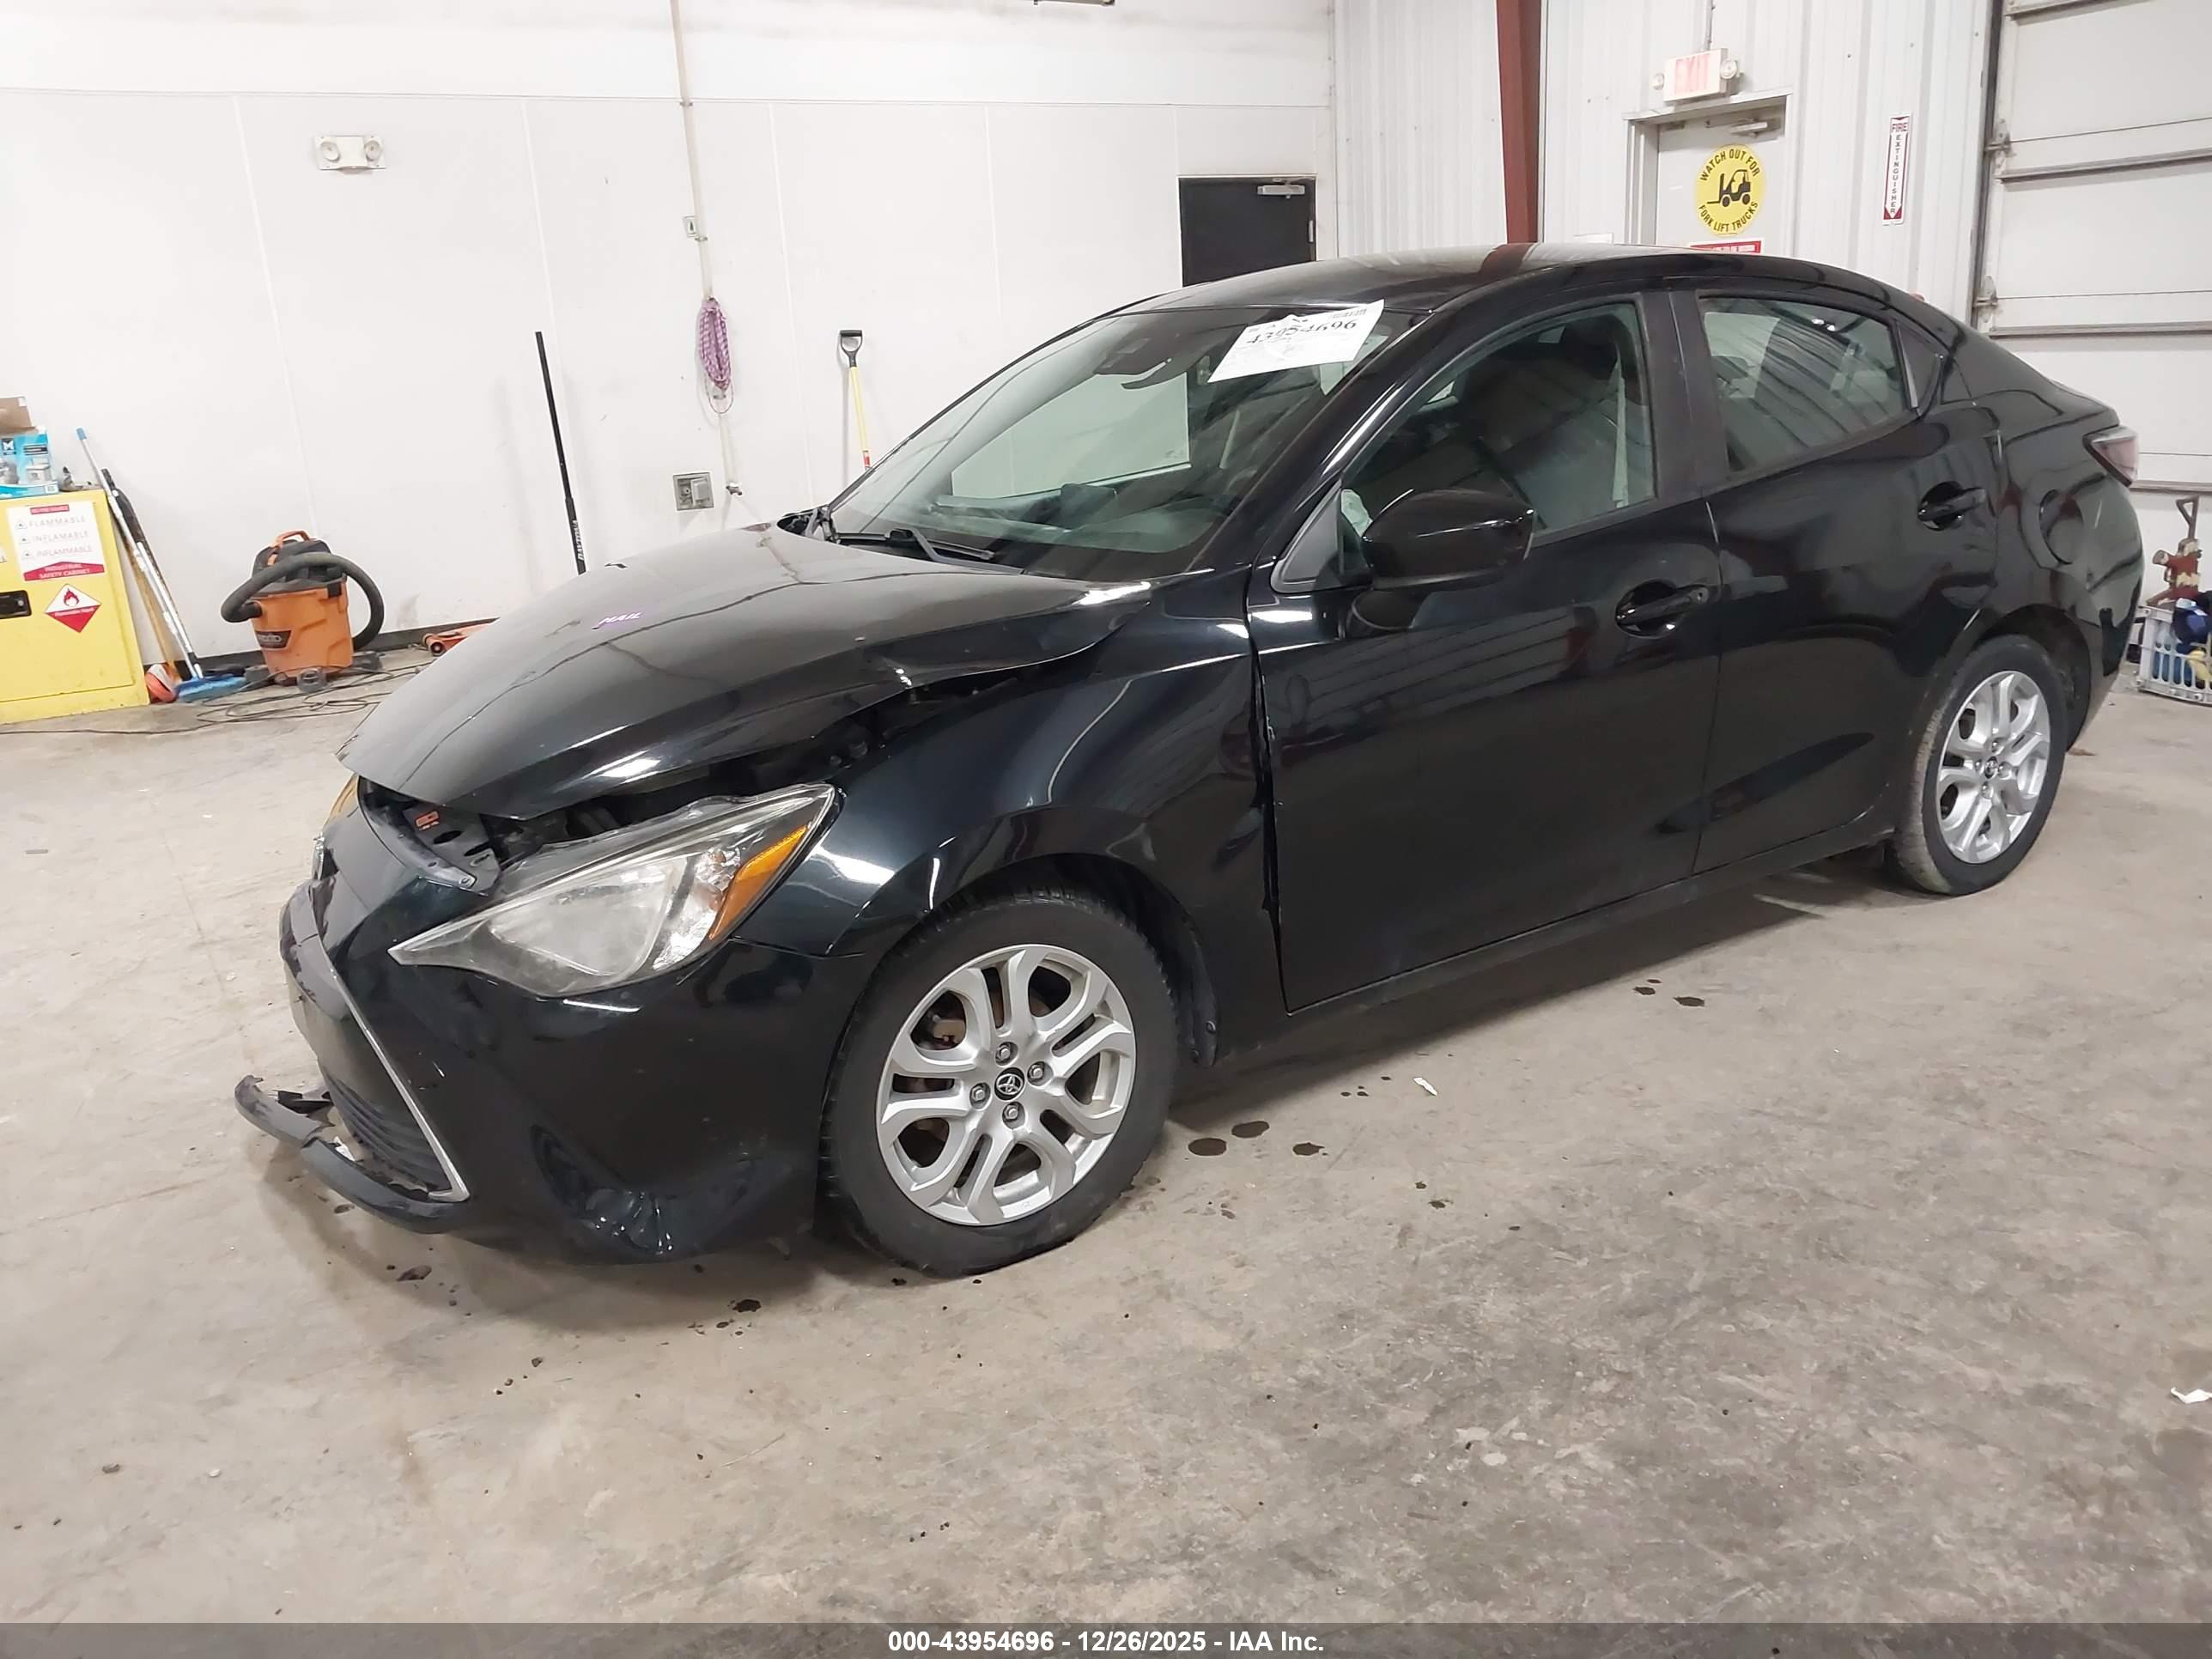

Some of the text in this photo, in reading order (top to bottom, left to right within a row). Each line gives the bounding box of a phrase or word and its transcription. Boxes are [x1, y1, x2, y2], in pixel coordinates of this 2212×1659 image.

[1674, 53, 1710, 95] EXIT
[1891, 122, 1908, 132] FIRE
[1700, 149, 1760, 181] WATCH OUT FOR
[1890, 134, 1903, 213] EXTINGUISHER
[1698, 201, 1759, 233] FORK LIFT TRUCKS
[28, 515, 85, 527] FLAMMABLE
